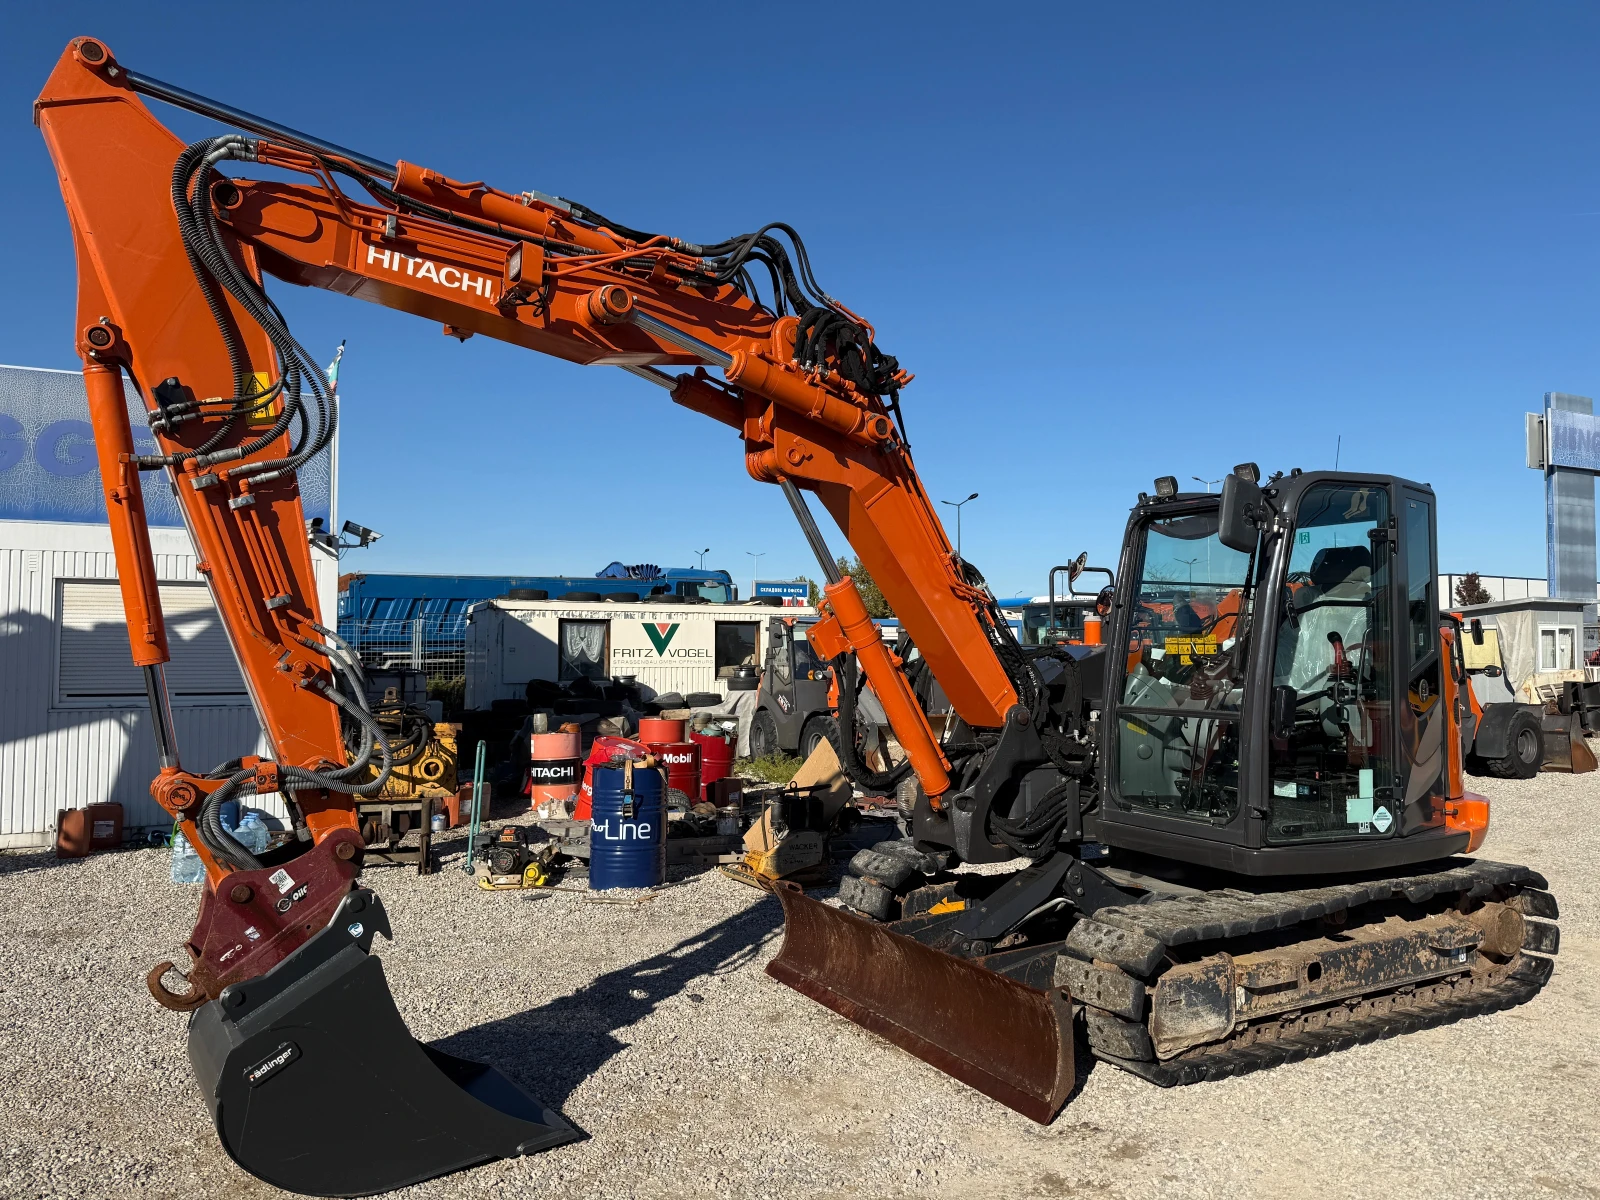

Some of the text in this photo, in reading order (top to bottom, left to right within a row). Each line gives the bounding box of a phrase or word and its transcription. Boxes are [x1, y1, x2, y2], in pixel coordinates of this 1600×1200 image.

[367, 245, 493, 299] HITACHI
[613, 648, 713, 658] FRITZ VOGEL
[663, 752, 693, 764] Mobil
[531, 766, 574, 778] HITACHI
[788, 843, 818, 851] WACKER
[249, 1047, 293, 1082] rädlinger
